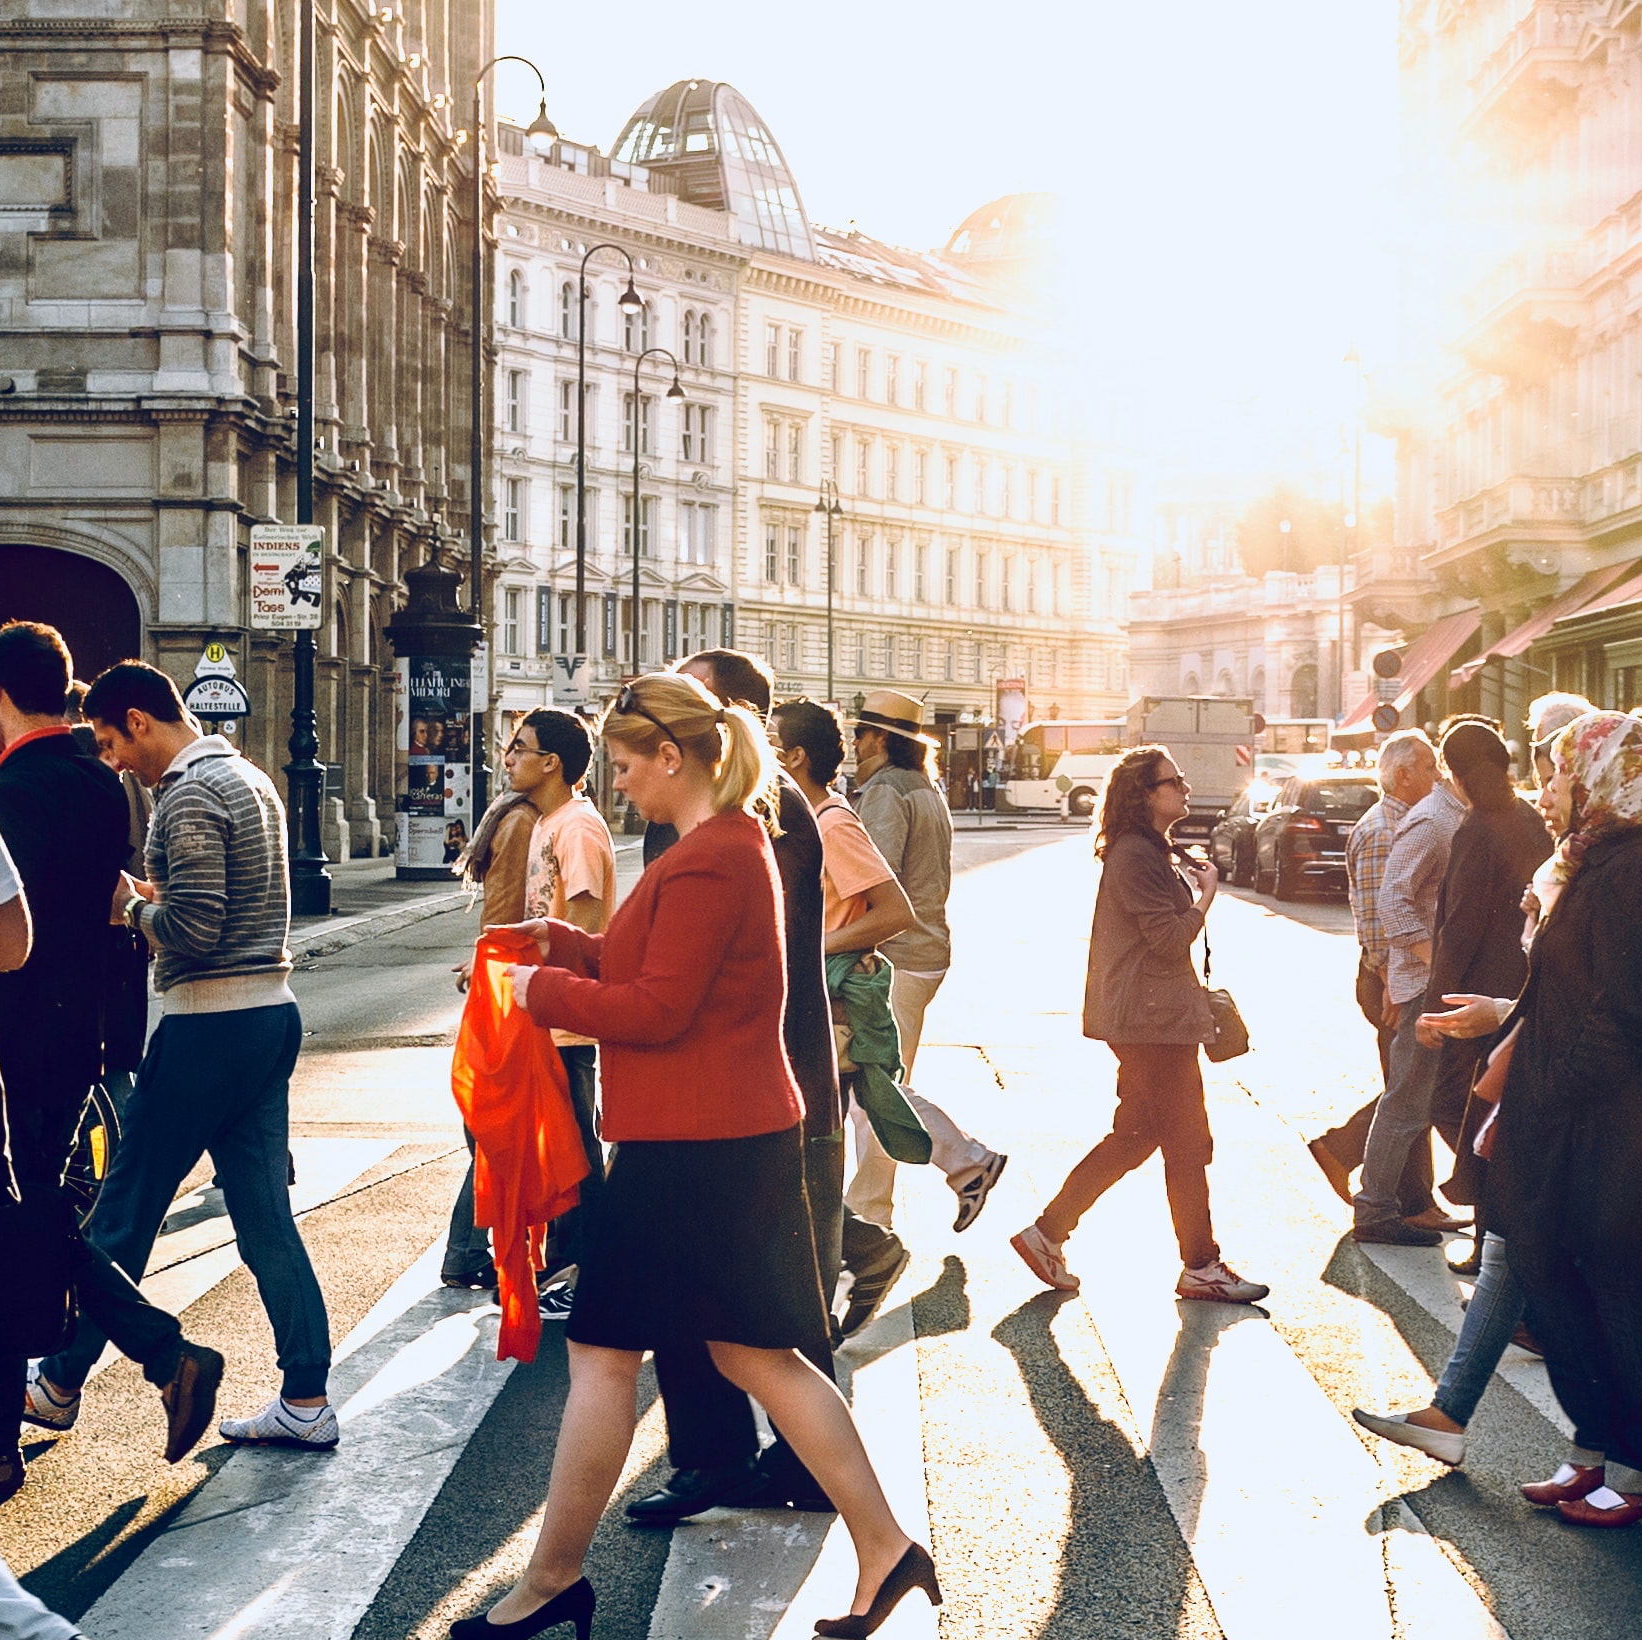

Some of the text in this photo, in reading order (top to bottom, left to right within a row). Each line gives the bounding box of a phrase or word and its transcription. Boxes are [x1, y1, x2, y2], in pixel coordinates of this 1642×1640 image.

[253, 541, 301, 551] INDIENS
[253, 600, 285, 613] Tass
[210, 646, 220, 659] H
[197, 681, 235, 696] AUTOBUS
[189, 702, 241, 711] HALTESTELLE
